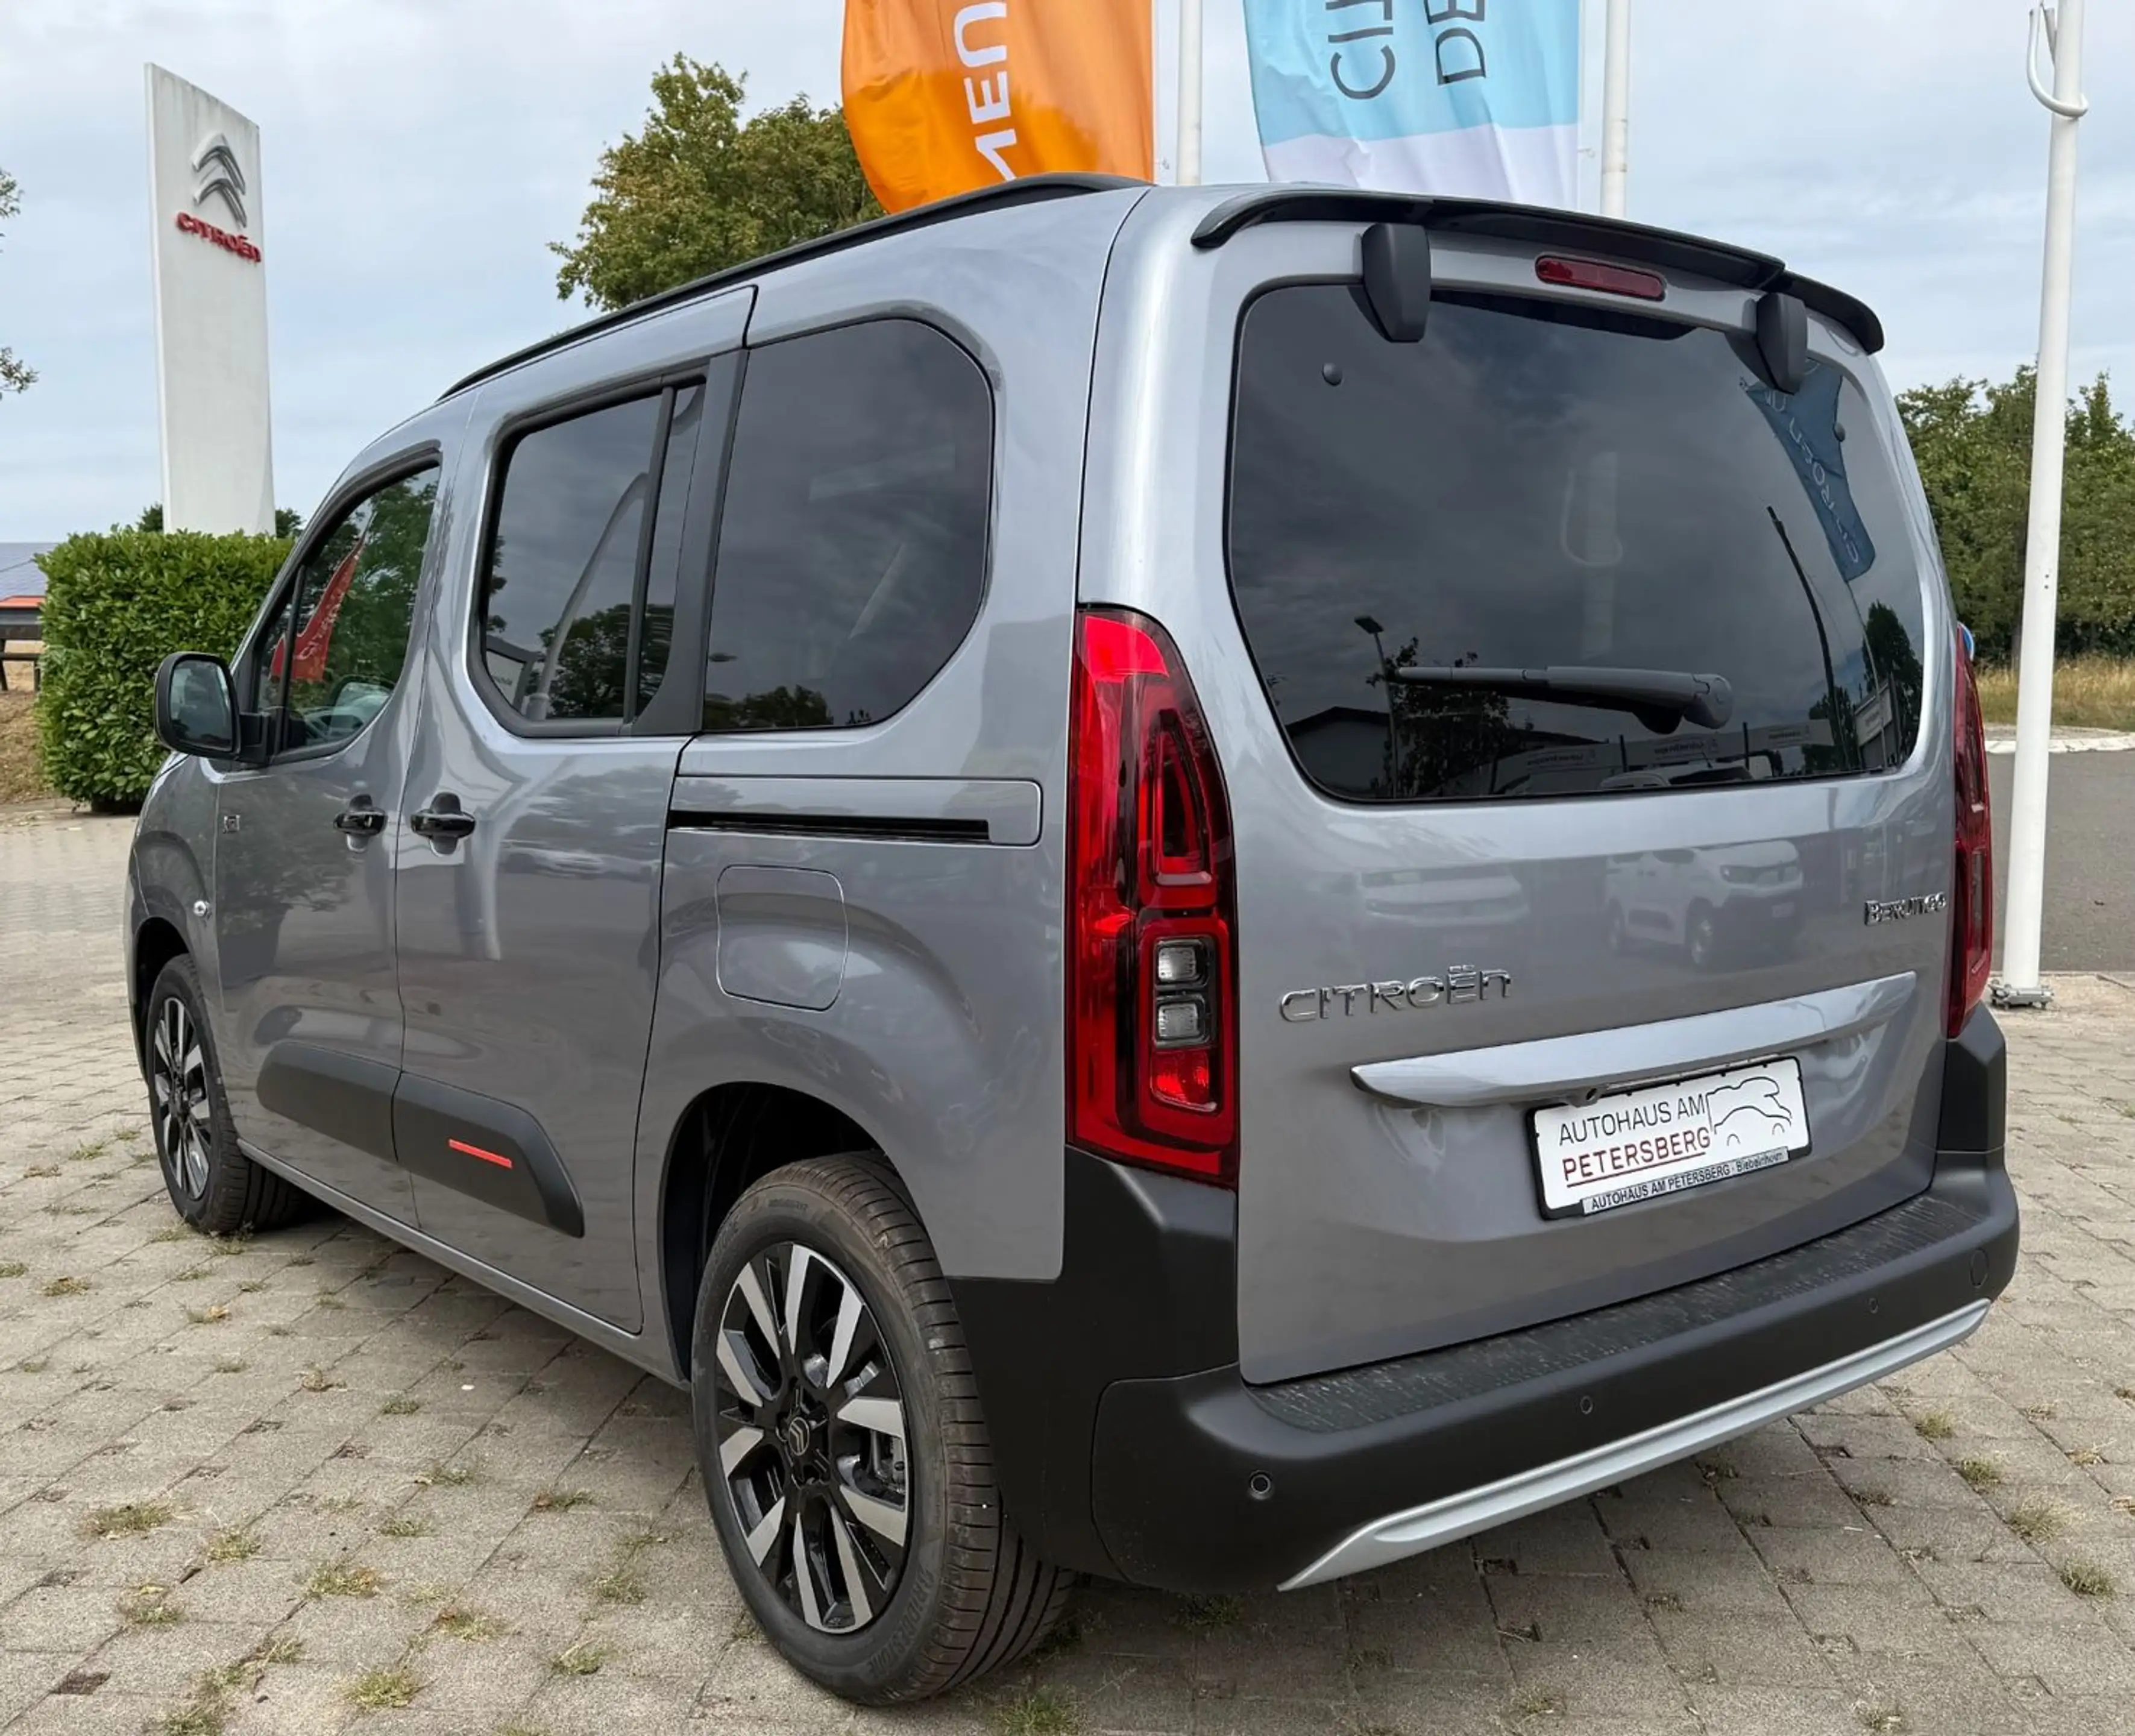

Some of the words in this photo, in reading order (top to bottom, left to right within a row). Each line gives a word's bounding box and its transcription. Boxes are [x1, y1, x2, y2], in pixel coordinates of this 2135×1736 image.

[1559, 1101, 1671, 1146] AUTOHAUS
[1677, 1093, 1705, 1120] AM
[1562, 1127, 1711, 1181] PETERSBERG
[1591, 1184, 1649, 1210] AUTOHAUS
[1651, 1180, 1666, 1194] AM
[1667, 1163, 1731, 1190] PETERSBERG
